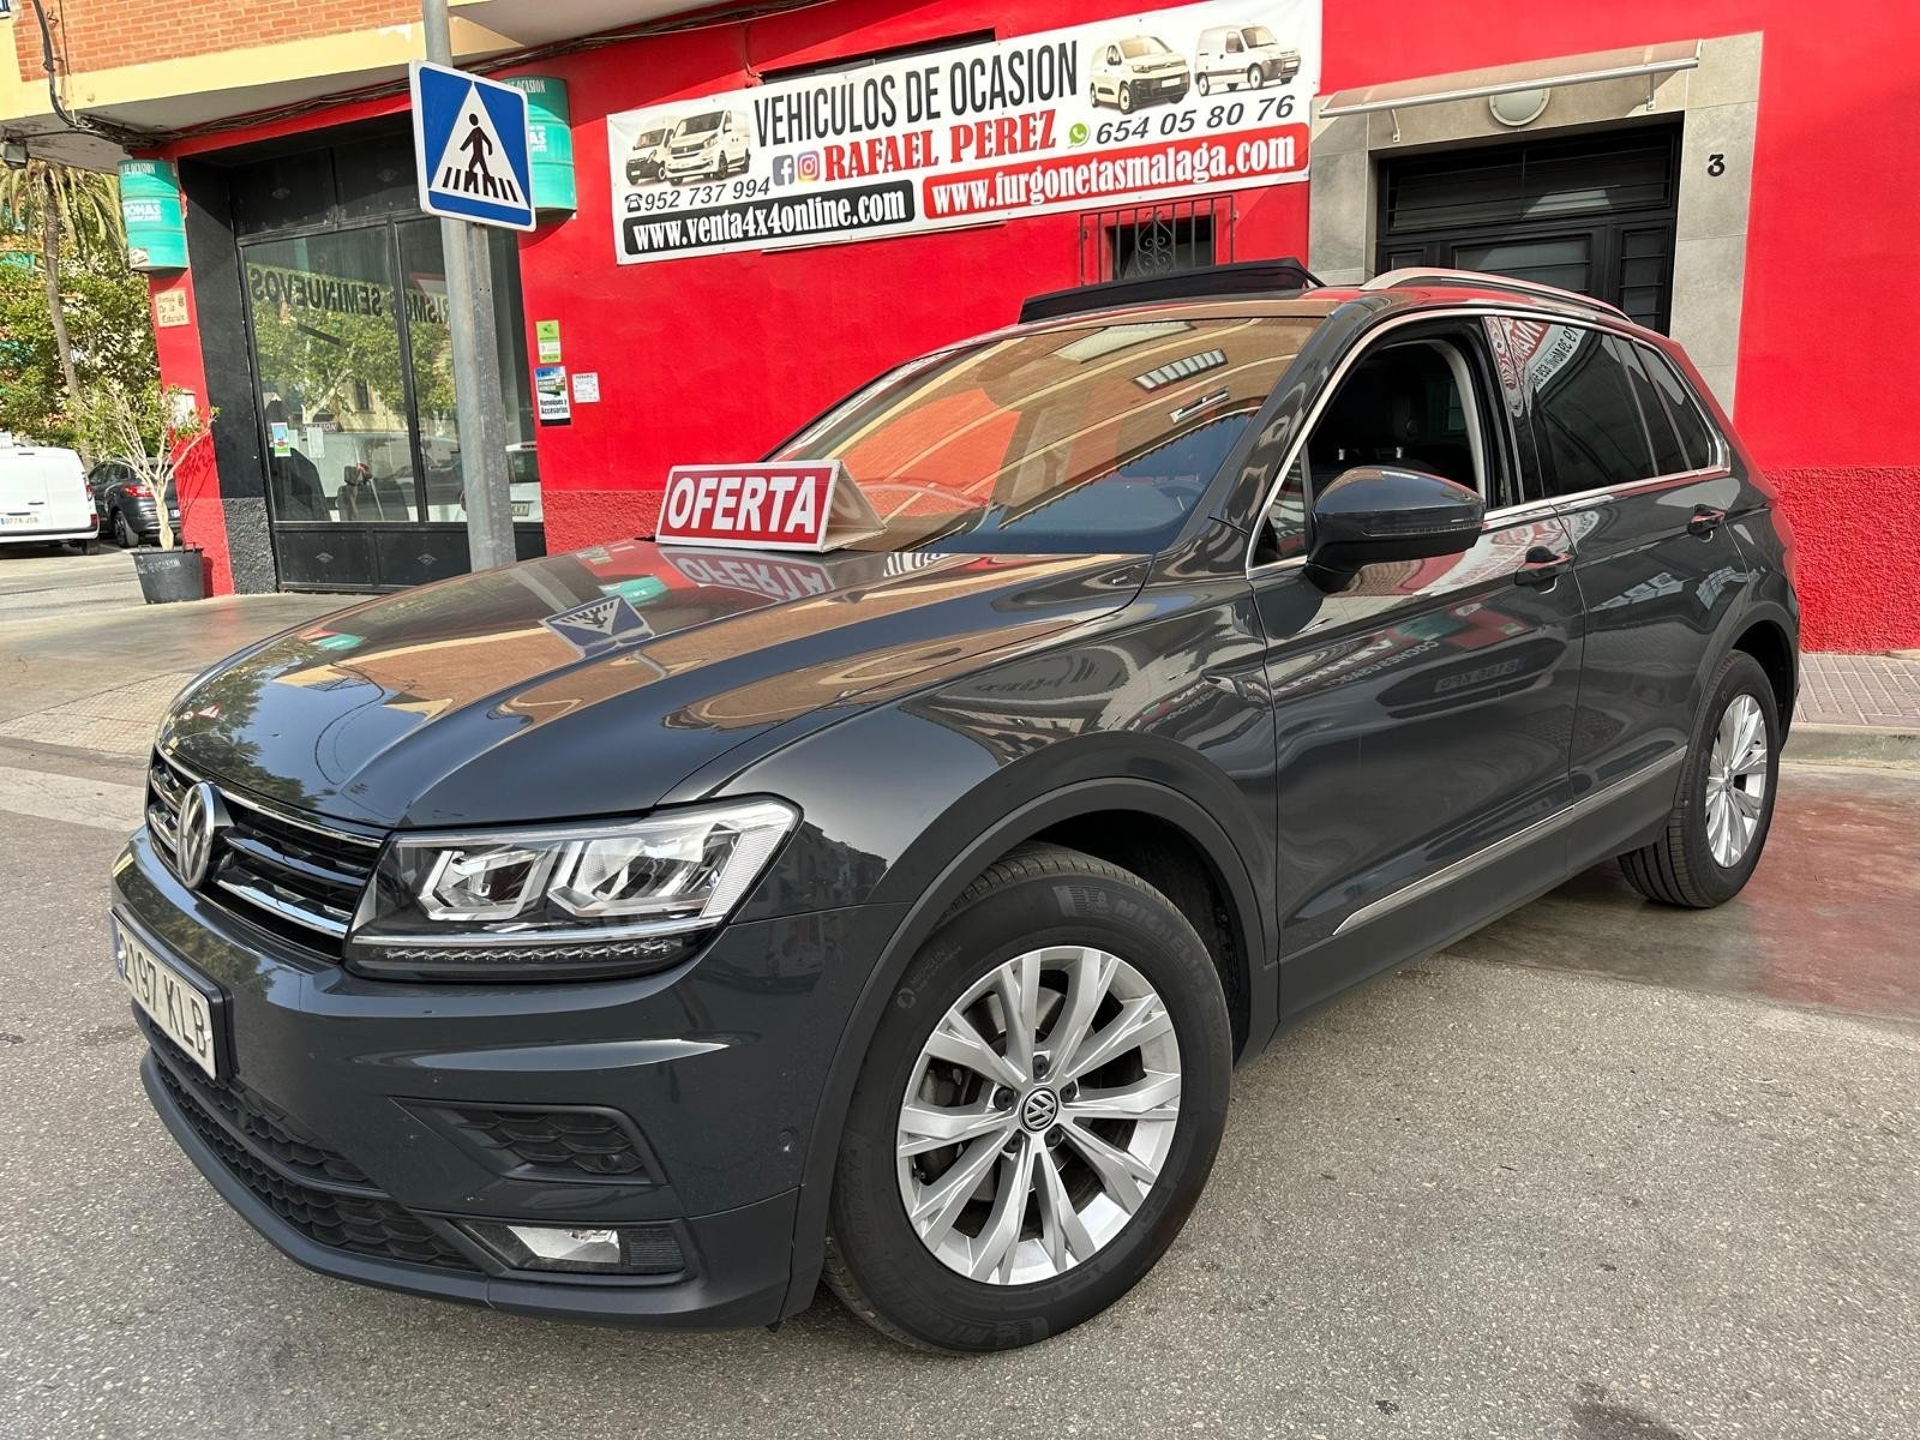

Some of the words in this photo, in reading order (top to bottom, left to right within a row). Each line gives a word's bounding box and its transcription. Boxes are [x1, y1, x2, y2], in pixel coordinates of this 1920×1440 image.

[754, 74, 896, 148] VEHICULOS
[906, 66, 941, 124] DE
[950, 40, 1078, 116] OCASION
[1096, 117, 1149, 145] 654
[1159, 109, 1197, 136] 05
[1206, 102, 1244, 129] 80
[1257, 94, 1296, 121] 76
[823, 130, 939, 182] RAFAEL
[950, 109, 1057, 163] PEREZ
[931, 135, 1295, 215] www.furgonetasmalaga.com
[1707, 154, 1725, 177] 3
[633, 189, 906, 251] www.venta4x4online.com
[645, 190, 680, 212] 952
[688, 183, 726, 206] 737
[732, 176, 771, 201] 994
[668, 476, 816, 534] OFERTA
[119, 932, 157, 1013] 2197
[163, 972, 207, 1059] KLB
